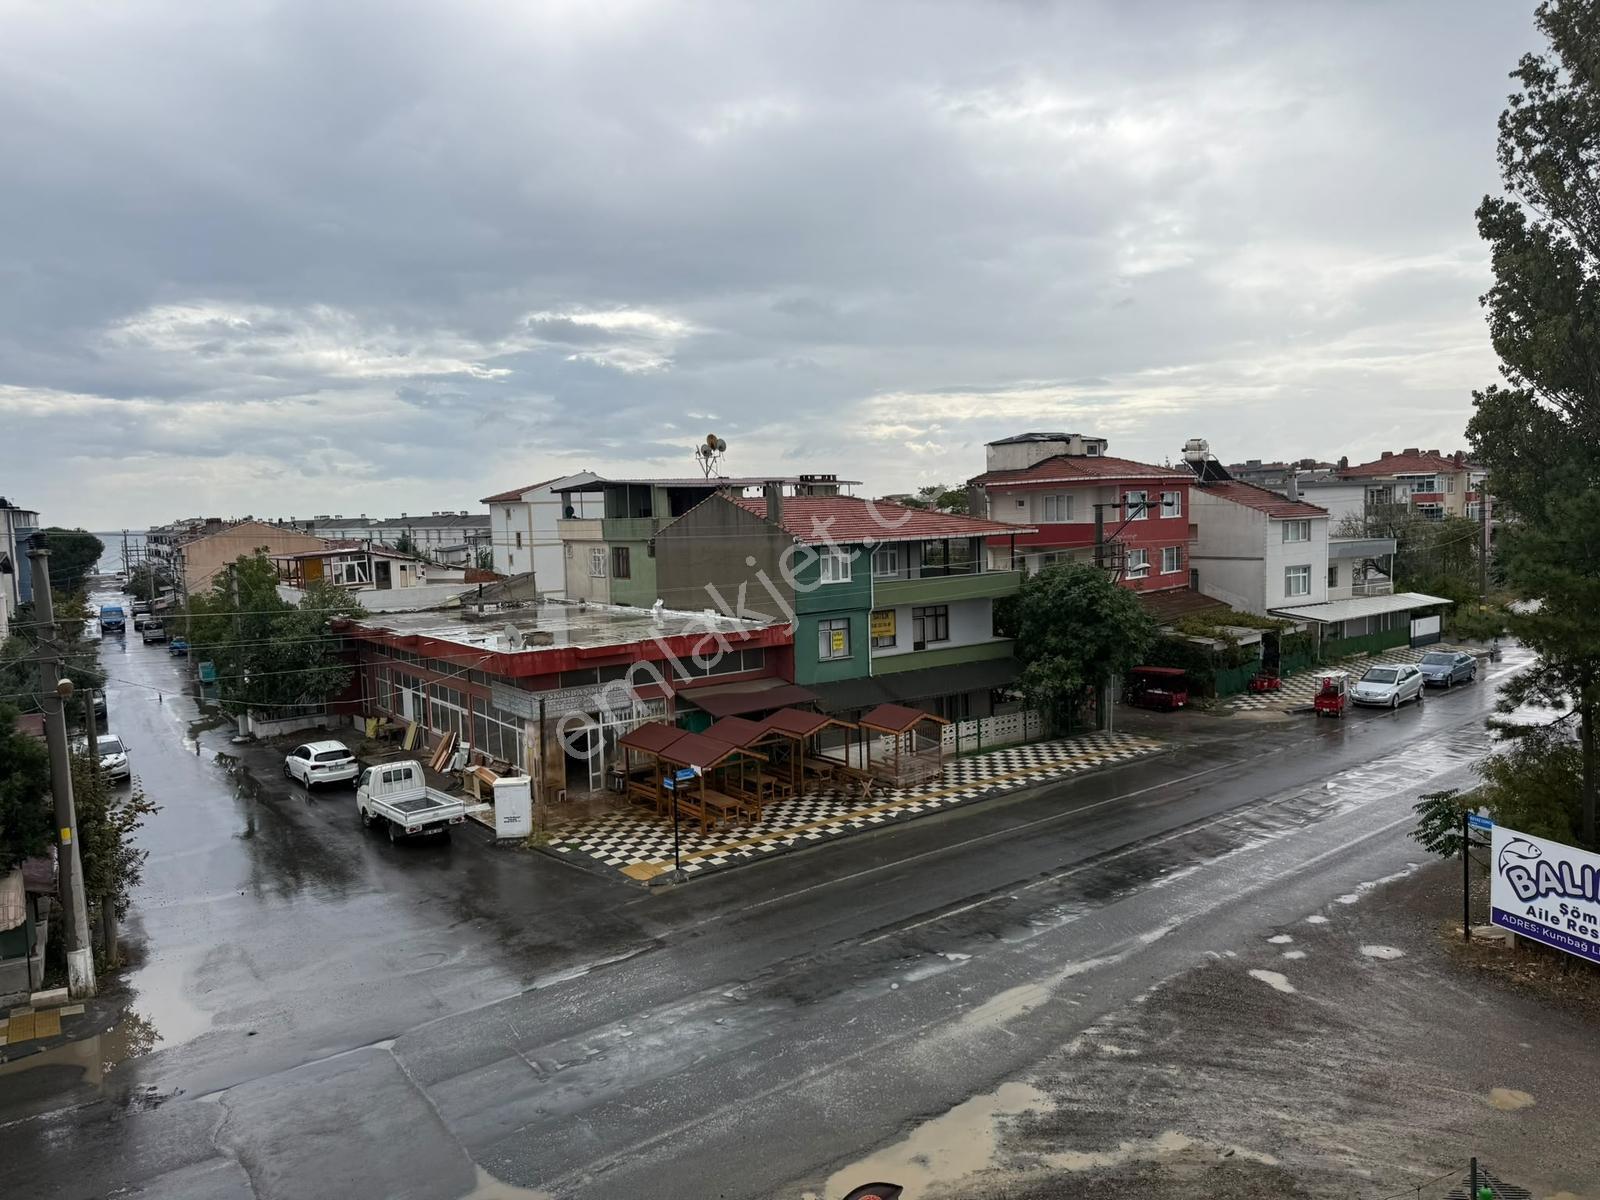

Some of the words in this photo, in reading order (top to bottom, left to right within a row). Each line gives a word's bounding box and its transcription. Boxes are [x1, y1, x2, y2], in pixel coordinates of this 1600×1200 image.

[1506, 860, 1600, 905] BALI
[1502, 914, 1540, 933] ADRES:
[1542, 928, 1588, 952] Kumbağ
[1526, 905, 1560, 925] Aile
